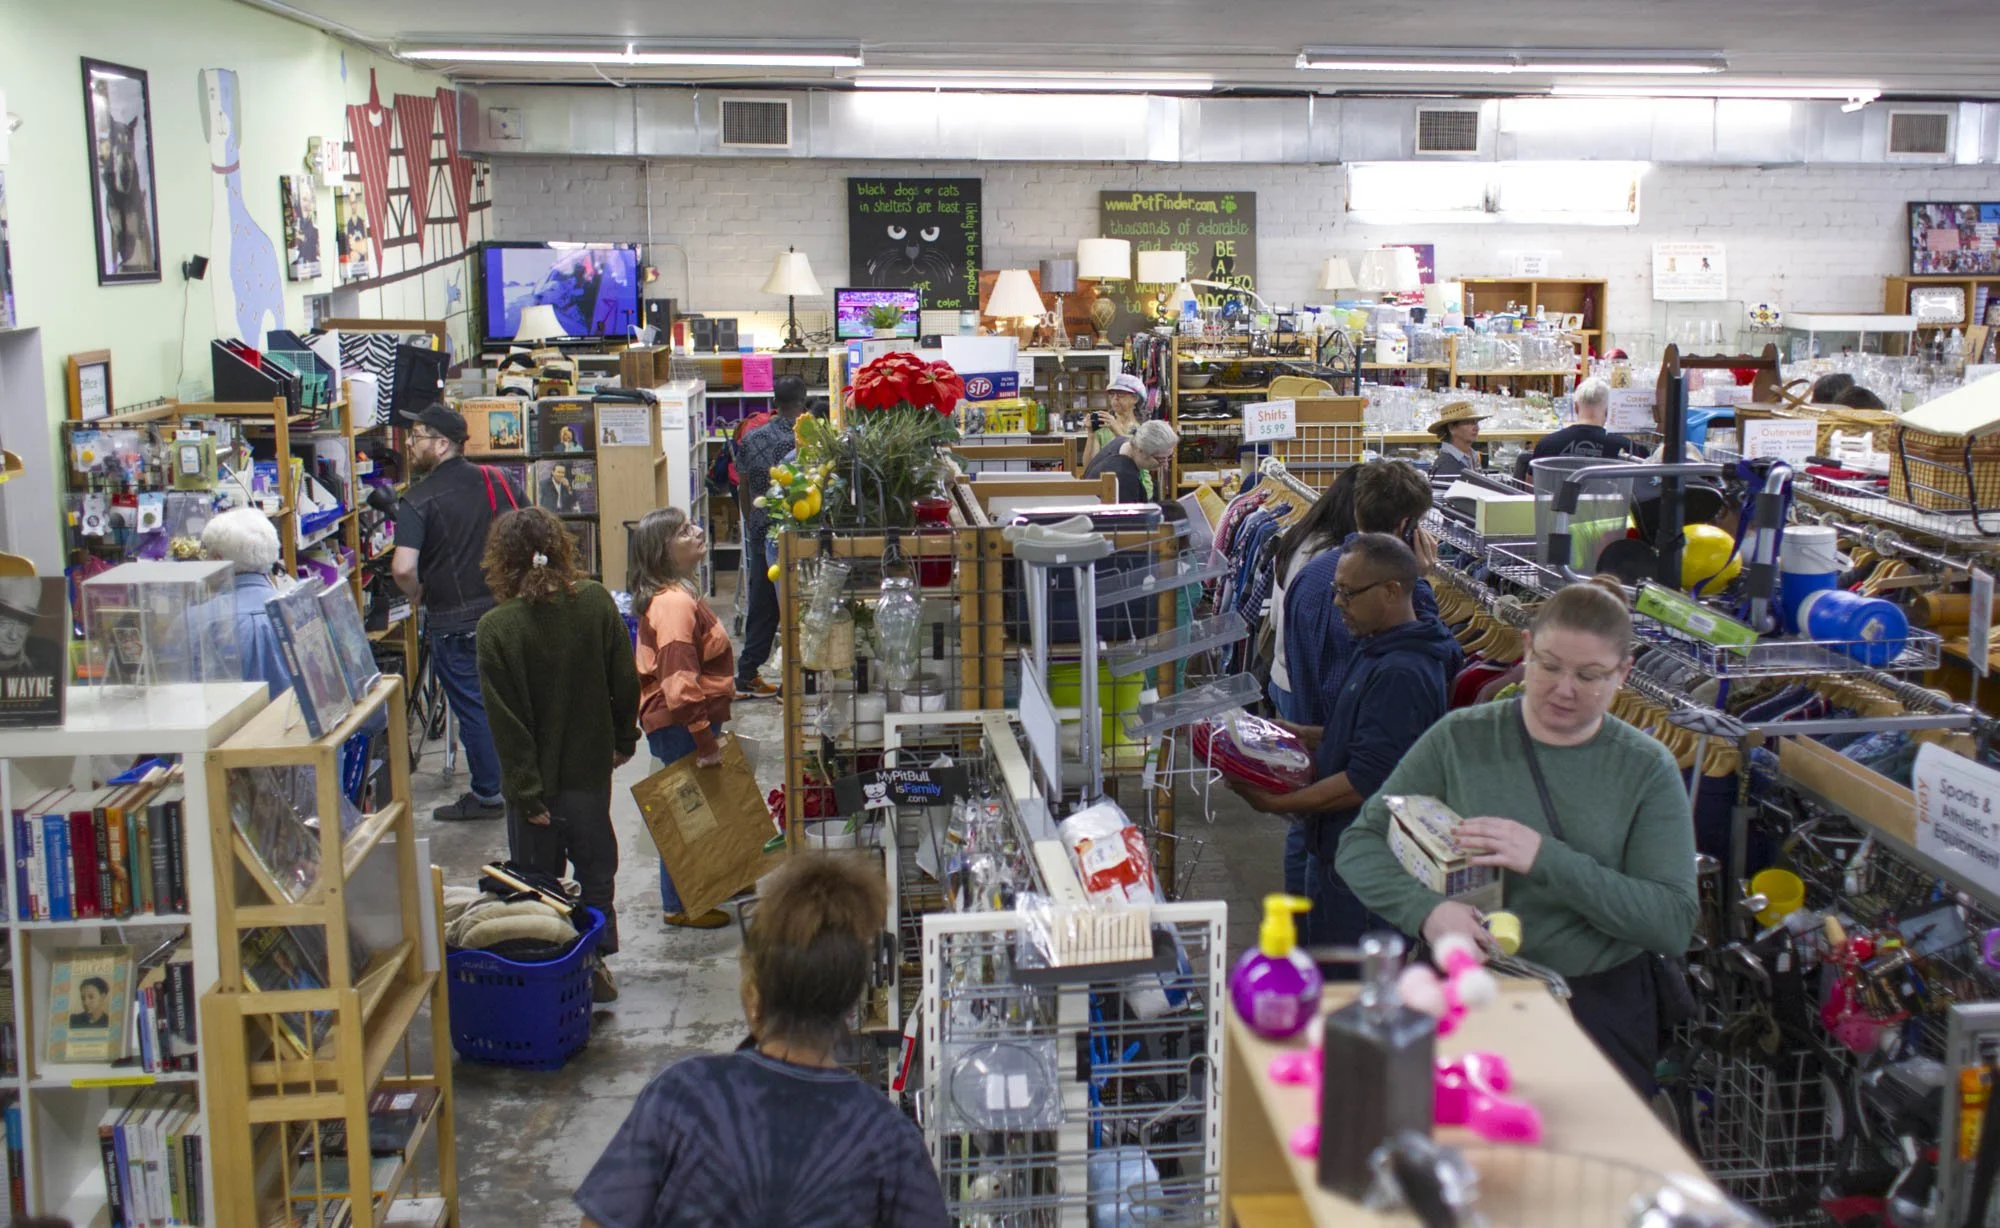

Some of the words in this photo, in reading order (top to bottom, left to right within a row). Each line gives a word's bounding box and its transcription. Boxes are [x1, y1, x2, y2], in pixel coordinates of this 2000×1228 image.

[326, 140, 340, 172] EXIT
[857, 183, 886, 195] black
[894, 182, 919, 201] dogs
[938, 184, 959, 196] cats
[860, 202, 869, 212] in
[874, 201, 912, 213] shelters
[917, 202, 931, 213] are
[938, 201, 960, 213] least
[961, 203, 978, 228] likely
[1110, 218, 1171, 236] thousands
[1178, 218, 1191, 236] of
[1197, 218, 1249, 236] adorable
[965, 231, 979, 242] to
[966, 244, 979, 257] be
[1138, 239, 1161, 252] and
[1170, 239, 1199, 259] dogs
[1215, 240, 1237, 257] BE
[1215, 259, 1226, 274] A
[1124, 296, 1141, 313] to
[969, 380, 990, 395] STP
[1258, 409, 1288, 422] Shirts
[1761, 427, 1812, 437] Outerwear
[8, 676, 54, 697] WAYNE
[876, 770, 931, 784] MyPitBull
[895, 782, 941, 797] isFamily
[1940, 779, 1979, 808] Sports
[1982, 797, 1991, 814] &
[1942, 804, 1989, 839] Athletic
[174, 967, 183, 991] PARTING
[109, 1163, 117, 1184] Human
[112, 1185, 120, 1206] Impact
